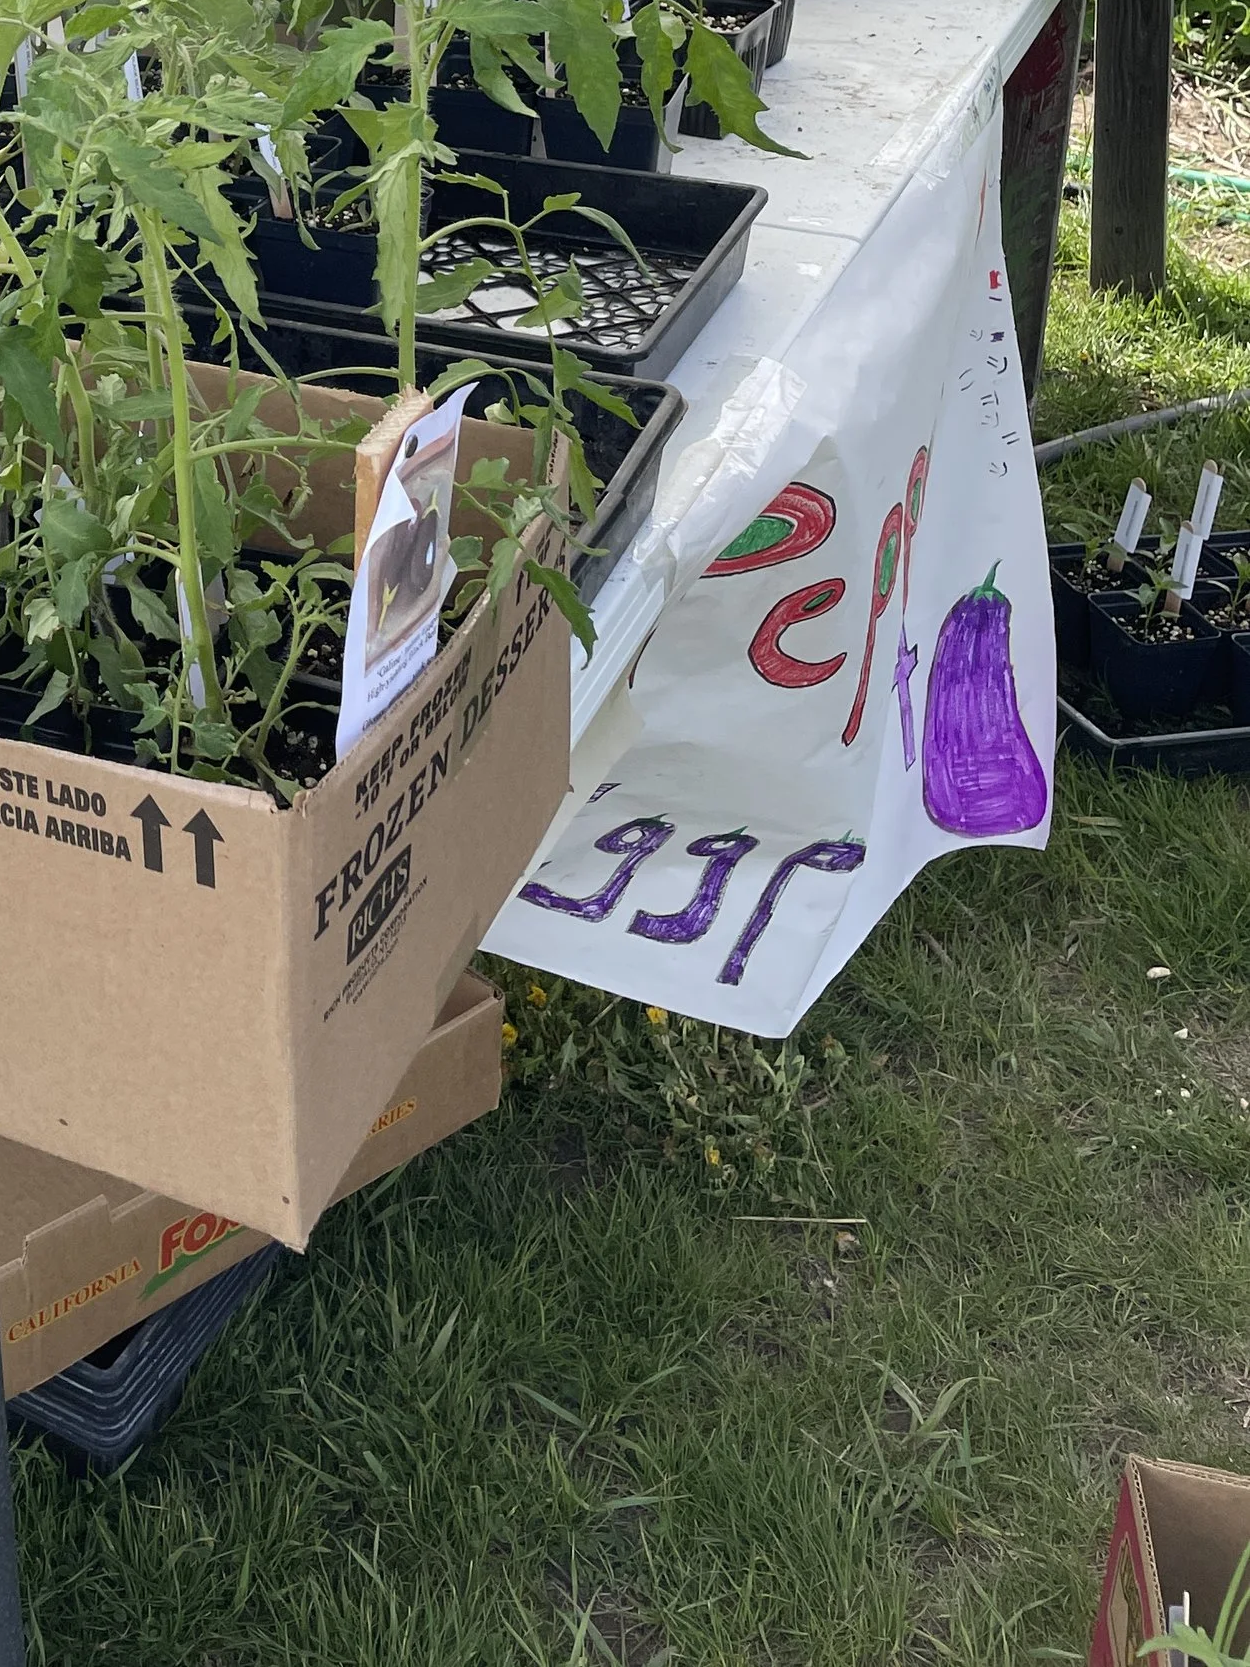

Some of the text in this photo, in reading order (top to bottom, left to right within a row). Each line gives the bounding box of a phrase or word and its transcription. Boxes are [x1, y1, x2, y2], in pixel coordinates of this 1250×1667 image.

[313, 731, 453, 942] FROZEN
[459, 537, 567, 751] DESSERS
[355, 733, 404, 807] KEEP
[409, 645, 472, 741] FROZEN
[399, 741, 420, 768] OR
[424, 673, 469, 740] BELOW
[44, 814, 132, 862] ARRIBA
[46, 781, 107, 818] LADO
[6, 1258, 142, 1343] CALIFORNIA
